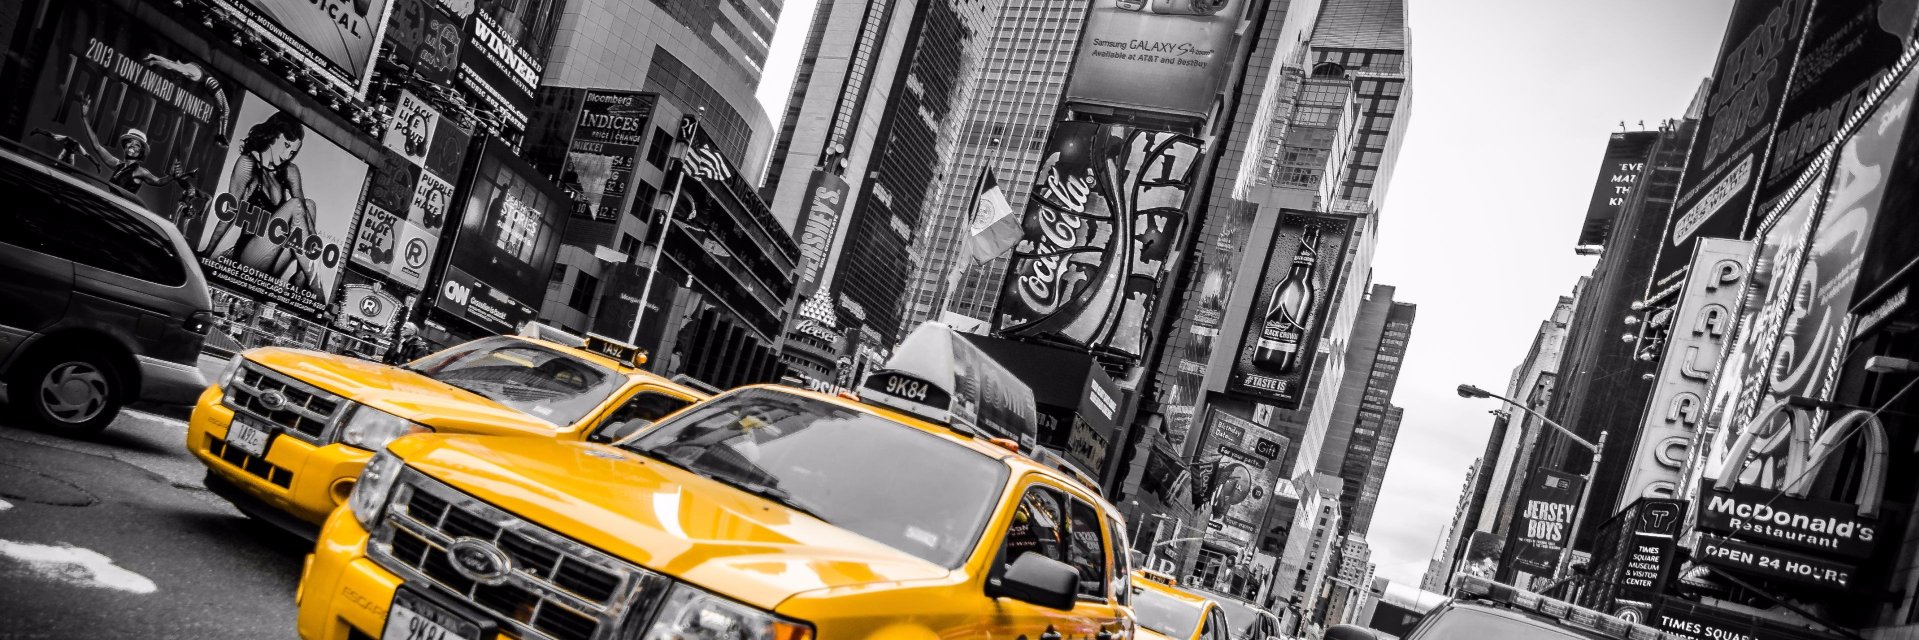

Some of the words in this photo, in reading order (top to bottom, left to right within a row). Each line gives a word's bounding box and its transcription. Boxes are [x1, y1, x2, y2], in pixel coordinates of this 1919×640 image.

[257, 15, 328, 68] MOTOWNTHEMUSICAL.COM
[497, 24, 519, 48] TONY
[517, 46, 542, 73] AWARD
[1093, 38, 1127, 50] Samsung
[1129, 39, 1176, 54] GALAXY
[475, 17, 539, 90] WINNER!
[1092, 49, 1126, 61] Available
[1127, 53, 1136, 62] at
[1138, 54, 1159, 64] AT&T
[1160, 56, 1175, 66] and
[1177, 58, 1208, 70] BestBuy
[471, 37, 487, 54] BEST
[487, 52, 512, 78] MUSICAL
[512, 75, 534, 99] REVIVAL
[86, 37, 114, 68] 2013
[115, 53, 144, 84] TONY
[140, 69, 175, 102] AWARD
[174, 87, 214, 124] WINNER!
[464, 77, 486, 98] MUSIC
[461, 62, 528, 124] PIPPINTHEMUSICAL.COM
[587, 92, 633, 107] Bloomberg
[398, 110, 420, 129] LIE
[402, 97, 434, 123] BLACK
[580, 109, 640, 132] INDICES
[394, 122, 424, 145] POWE
[592, 131, 609, 140] PRICE
[573, 140, 604, 153] NIKKEI
[417, 185, 438, 202] LIE
[421, 173, 453, 198] PURPLE
[368, 205, 398, 226] LIGHT
[500, 201, 538, 236] STORIES
[214, 192, 340, 269] CHICAGO
[361, 230, 384, 248] LIE
[799, 186, 840, 284] HERSHEY'S
[201, 257, 284, 294] TELECHARGE.COM/CHICAGO
[218, 255, 317, 300] CHICAGOTHEMUSICAL.COM
[445, 280, 470, 306] CNN
[602, 342, 623, 358] 1A92
[885, 375, 930, 401] 9K84
[1244, 374, 1279, 391] #TASTE
[1279, 379, 1287, 392] IS
[1641, 258, 1744, 500] PALACE
[1257, 441, 1276, 457] Gift
[1523, 499, 1575, 524] JERSEY
[1708, 495, 1875, 542] McDonald's
[1527, 519, 1563, 542] BOYS
[1633, 553, 1660, 563] SQUARE
[1638, 545, 1660, 555] TIMES
[1705, 545, 1754, 564] OPEN
[1758, 555, 1781, 571] 24
[1627, 562, 1660, 572] MUSEUM
[1632, 570, 1659, 580] VISITOR
[1626, 578, 1652, 588] CENTER
[1661, 615, 1701, 635] TIMES
[1704, 626, 1760, 640] SQUA
